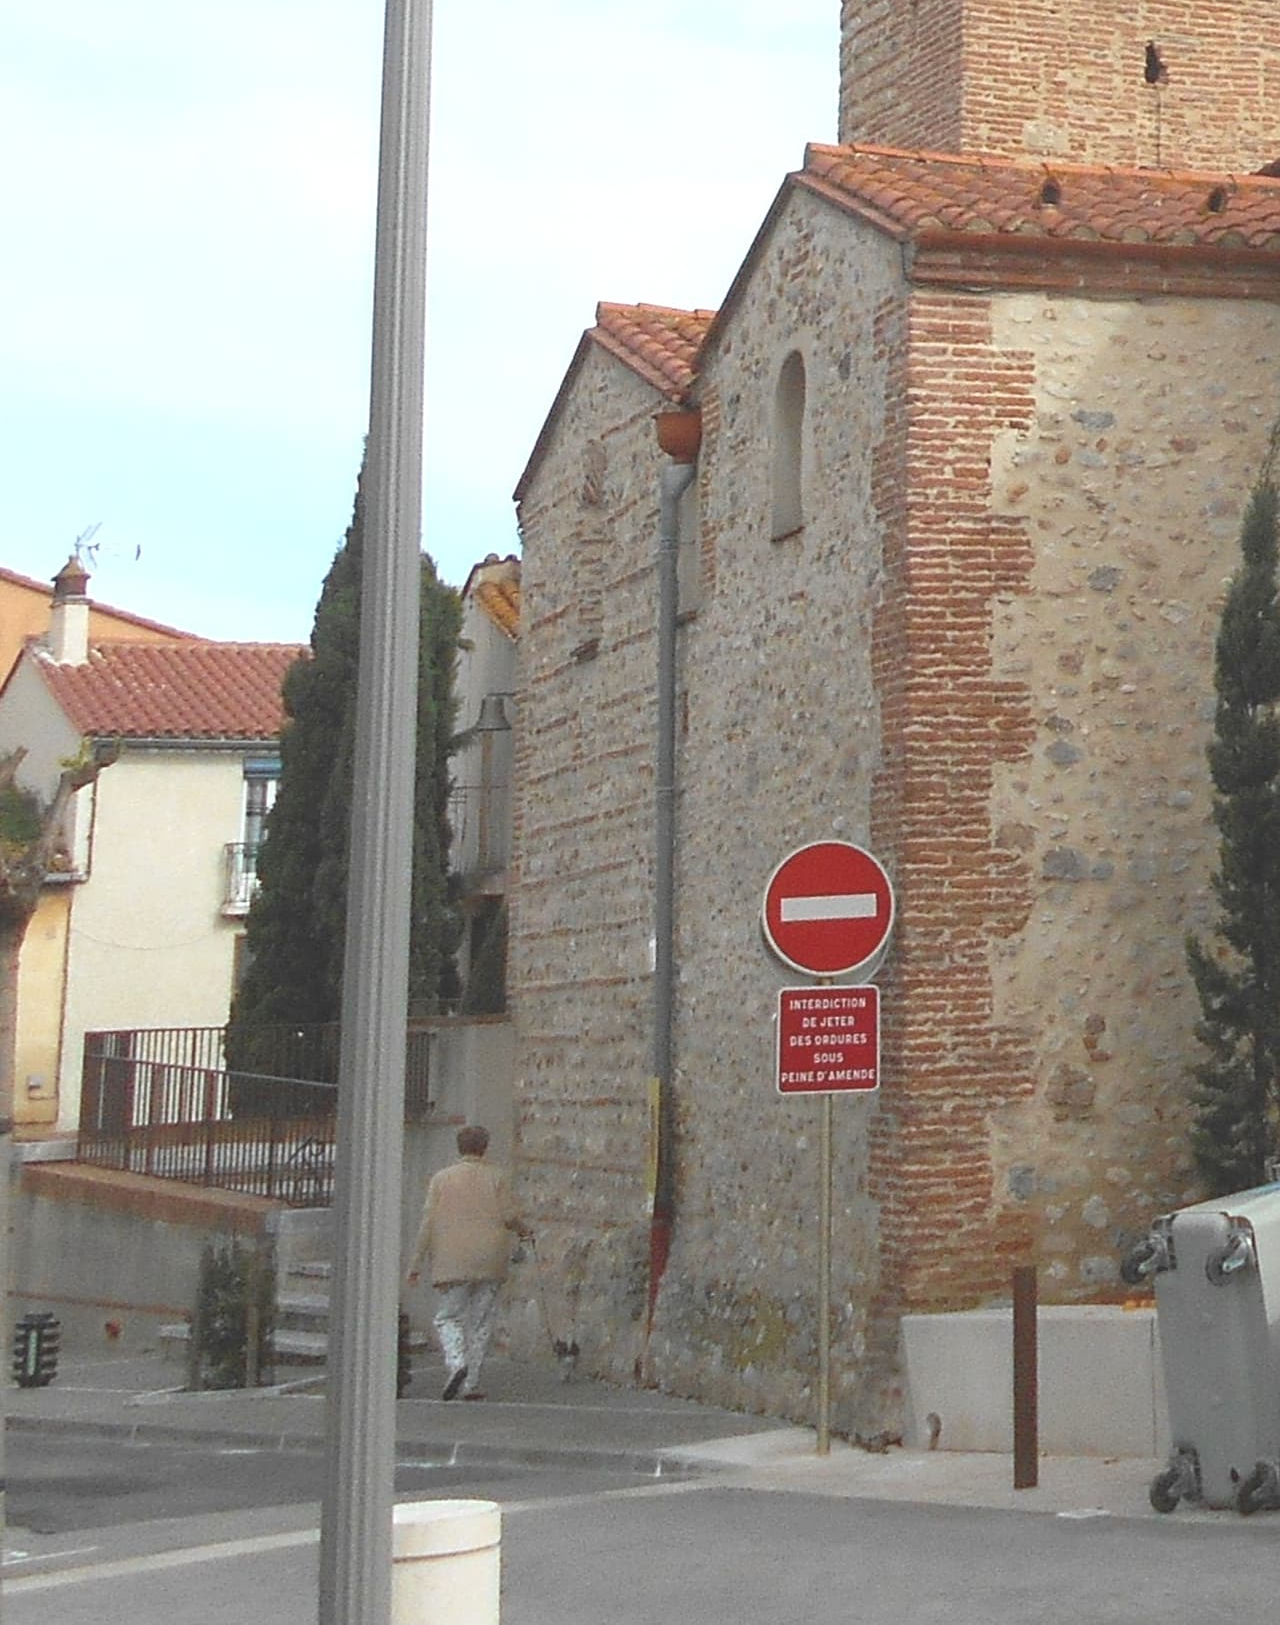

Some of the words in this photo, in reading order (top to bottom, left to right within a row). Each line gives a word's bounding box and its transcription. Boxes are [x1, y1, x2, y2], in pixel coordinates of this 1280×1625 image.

[789, 998, 866, 1010] INTERDICTION
[802, 1017, 816, 1028] DE
[820, 1016, 854, 1027] JETER
[789, 1036, 811, 1047] DES
[814, 1033, 867, 1045] ORDURES
[813, 1053, 843, 1063] SOUS
[781, 1072, 814, 1083] PEINE
